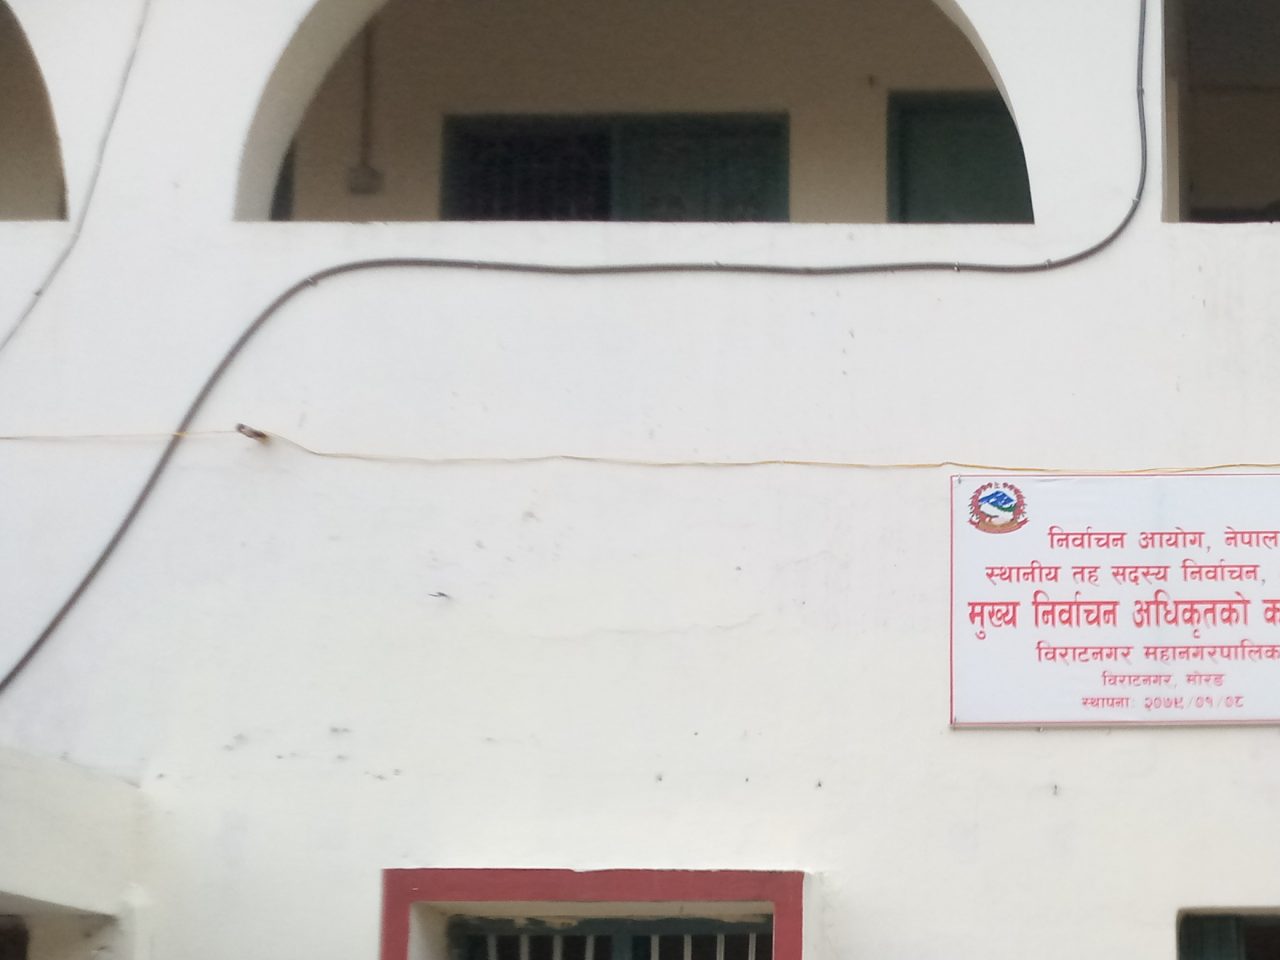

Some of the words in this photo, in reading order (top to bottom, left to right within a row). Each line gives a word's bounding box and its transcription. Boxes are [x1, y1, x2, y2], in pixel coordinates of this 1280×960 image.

[1047, 525, 1128, 549] निर्वाचन
[1138, 527, 1212, 552] आयोग,
[1224, 526, 1280, 549] नेपाल
[985, 560, 1062, 584] स्थानीय
[1071, 566, 1101, 586] तह
[1110, 565, 1171, 586] सदस्य
[1180, 558, 1267, 585] निर्वाचन,
[967, 600, 1021, 640] मुख्य
[1031, 589, 1120, 628] निर्वाचन
[1132, 589, 1252, 639] अधिकृतको
[1035, 640, 1134, 664] विराटनगर
